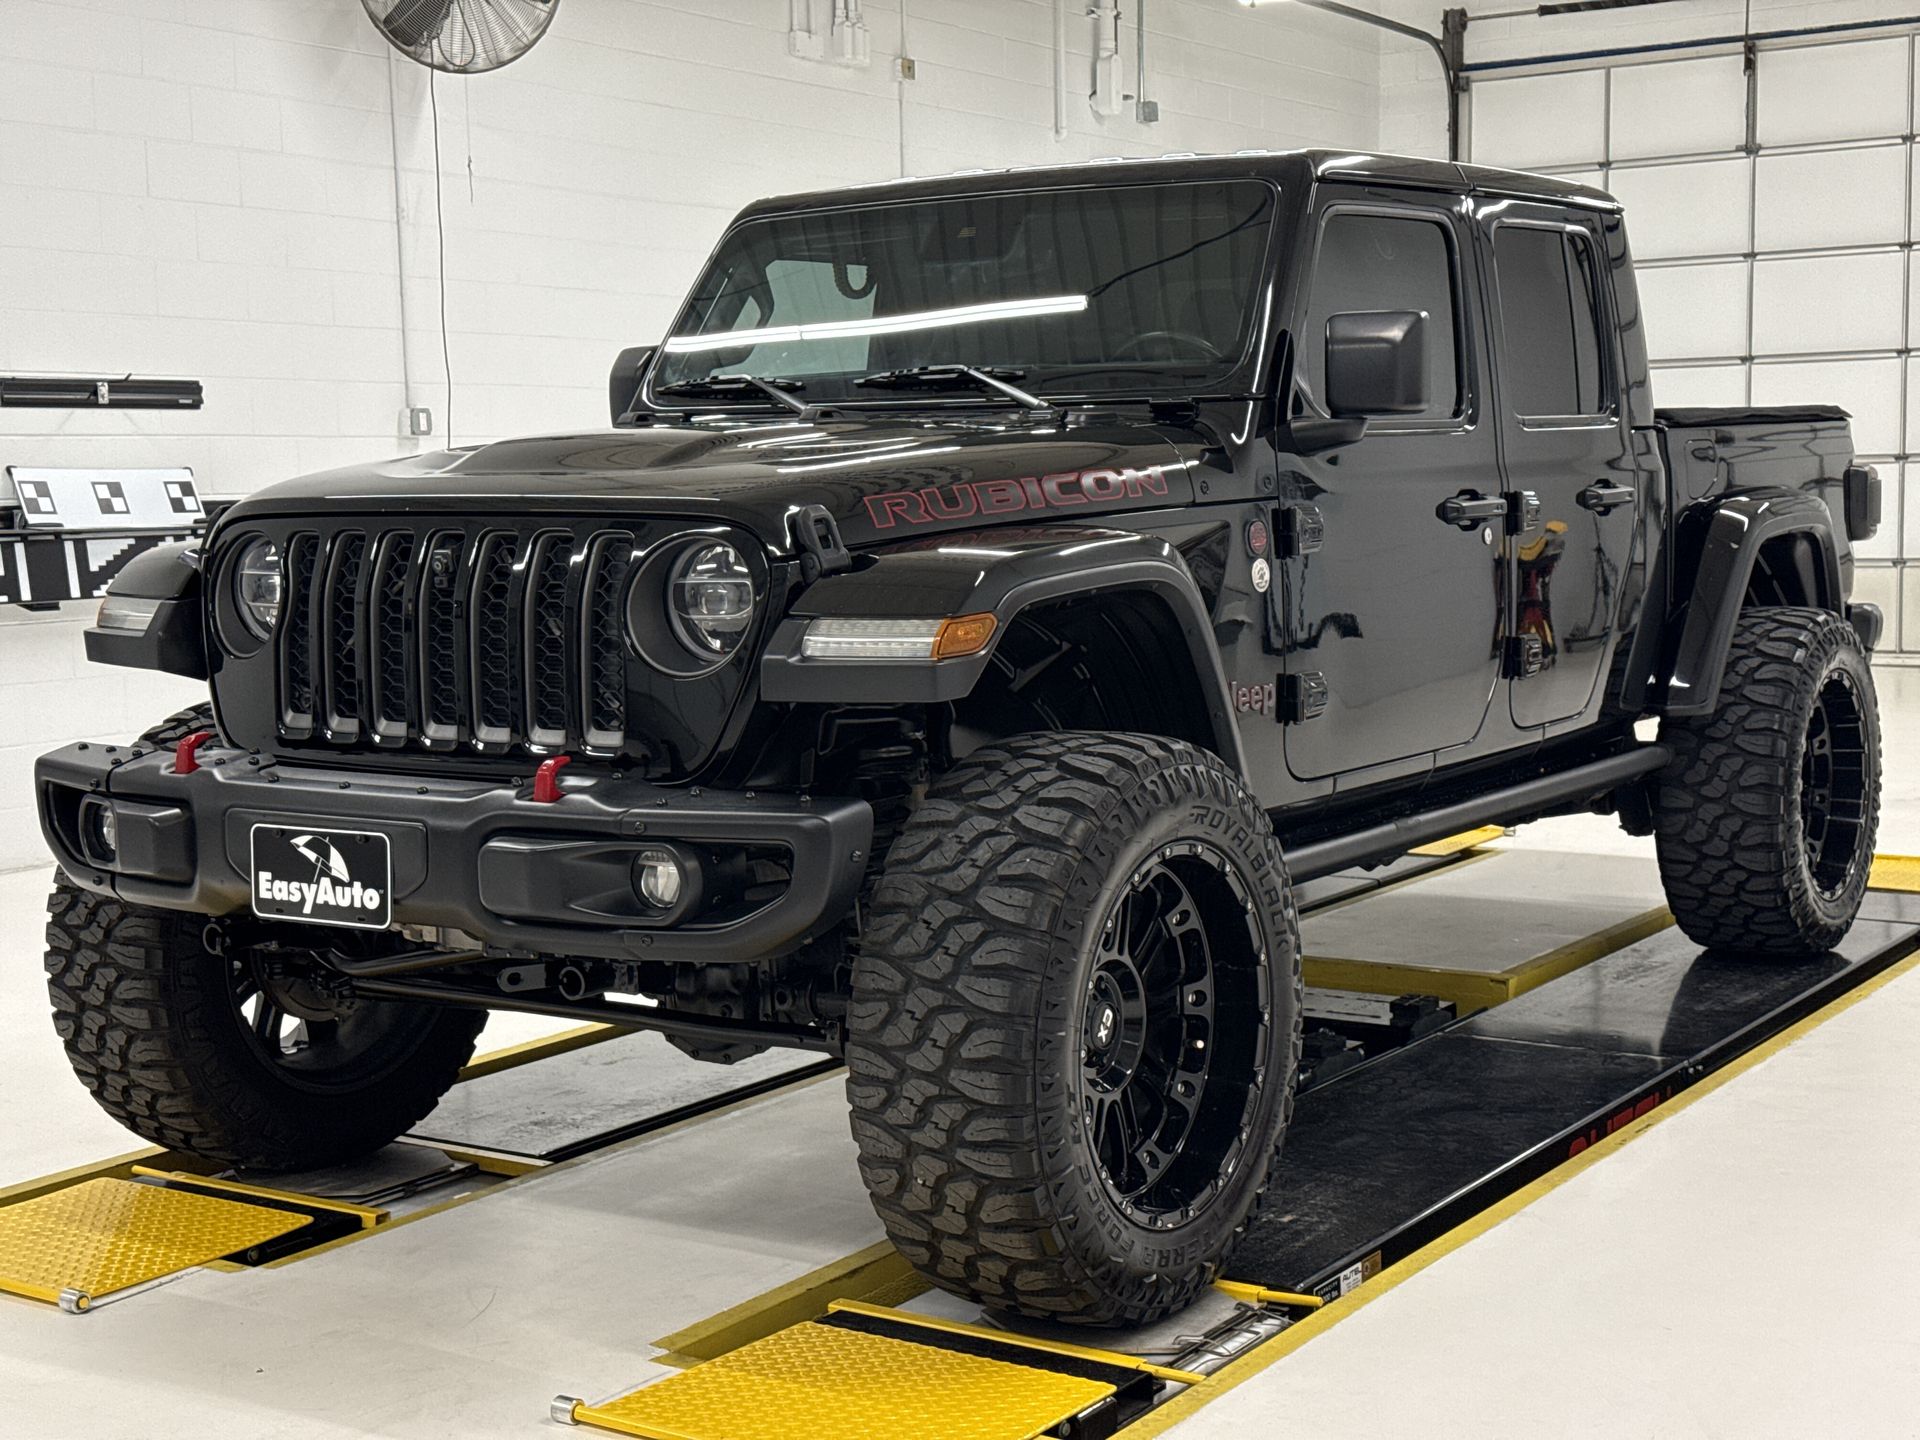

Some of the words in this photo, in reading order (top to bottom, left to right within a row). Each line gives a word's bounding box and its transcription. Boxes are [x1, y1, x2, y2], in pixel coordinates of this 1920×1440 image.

[863, 464, 1169, 529] RUBICON
[258, 870, 381, 915] EasyAuto
[1097, 1008, 1114, 1042] XD
